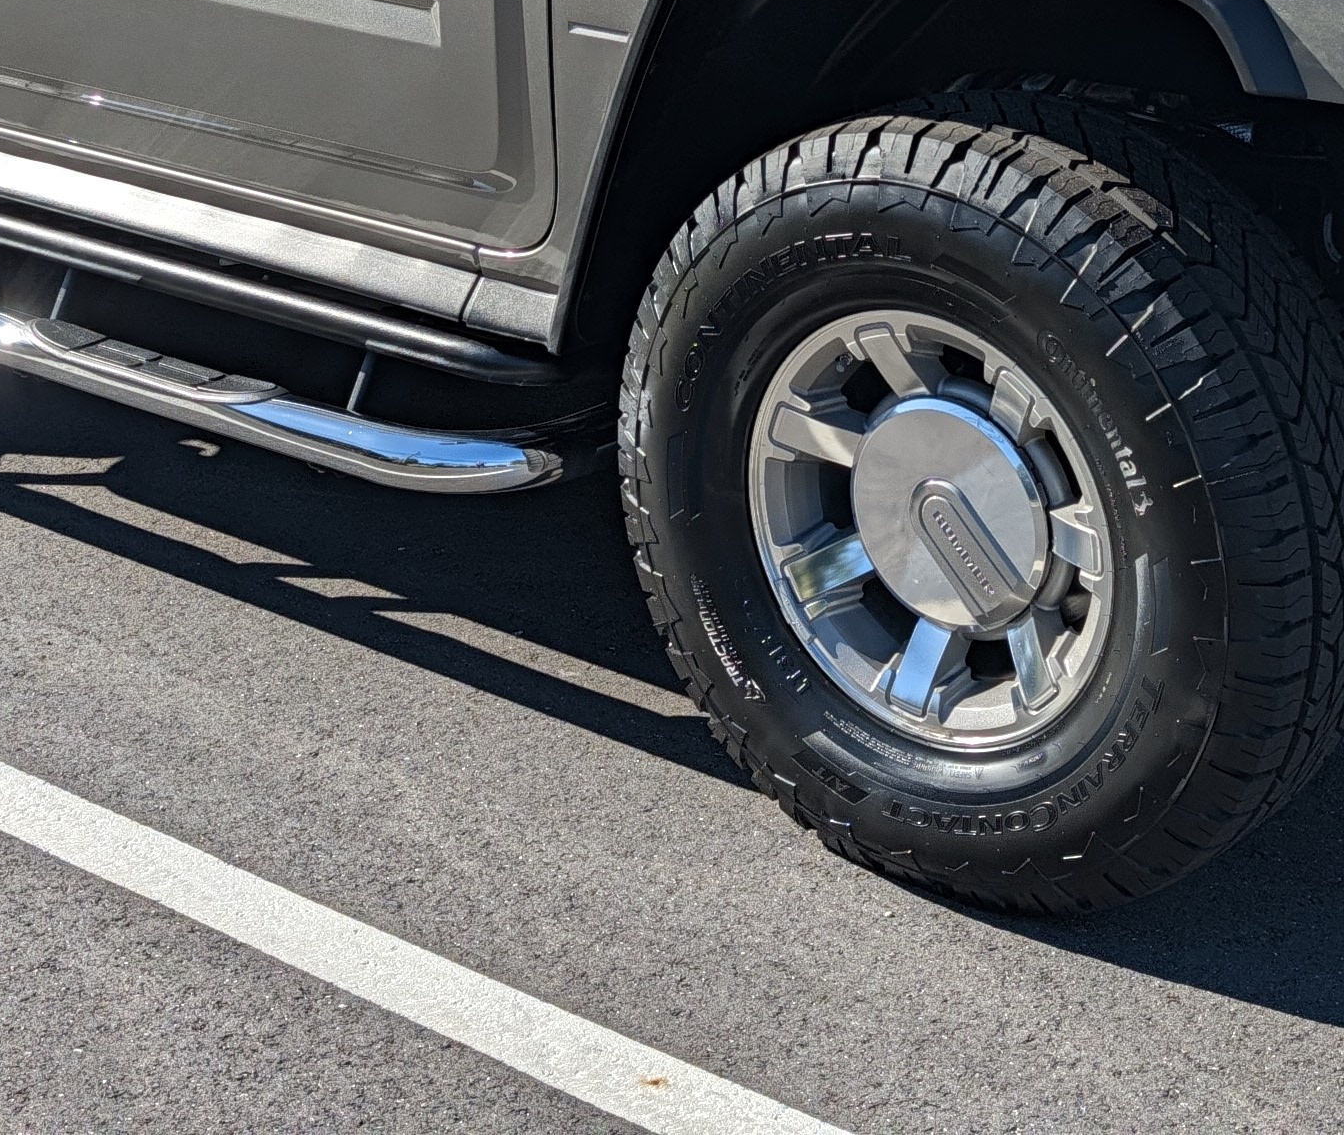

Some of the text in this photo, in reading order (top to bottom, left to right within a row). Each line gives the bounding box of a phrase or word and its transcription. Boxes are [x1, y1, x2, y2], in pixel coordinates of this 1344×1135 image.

[674, 231, 913, 413] CONTINENTAL
[1038, 329, 1148, 490] Continental
[932, 510, 995, 597] HUMMER
